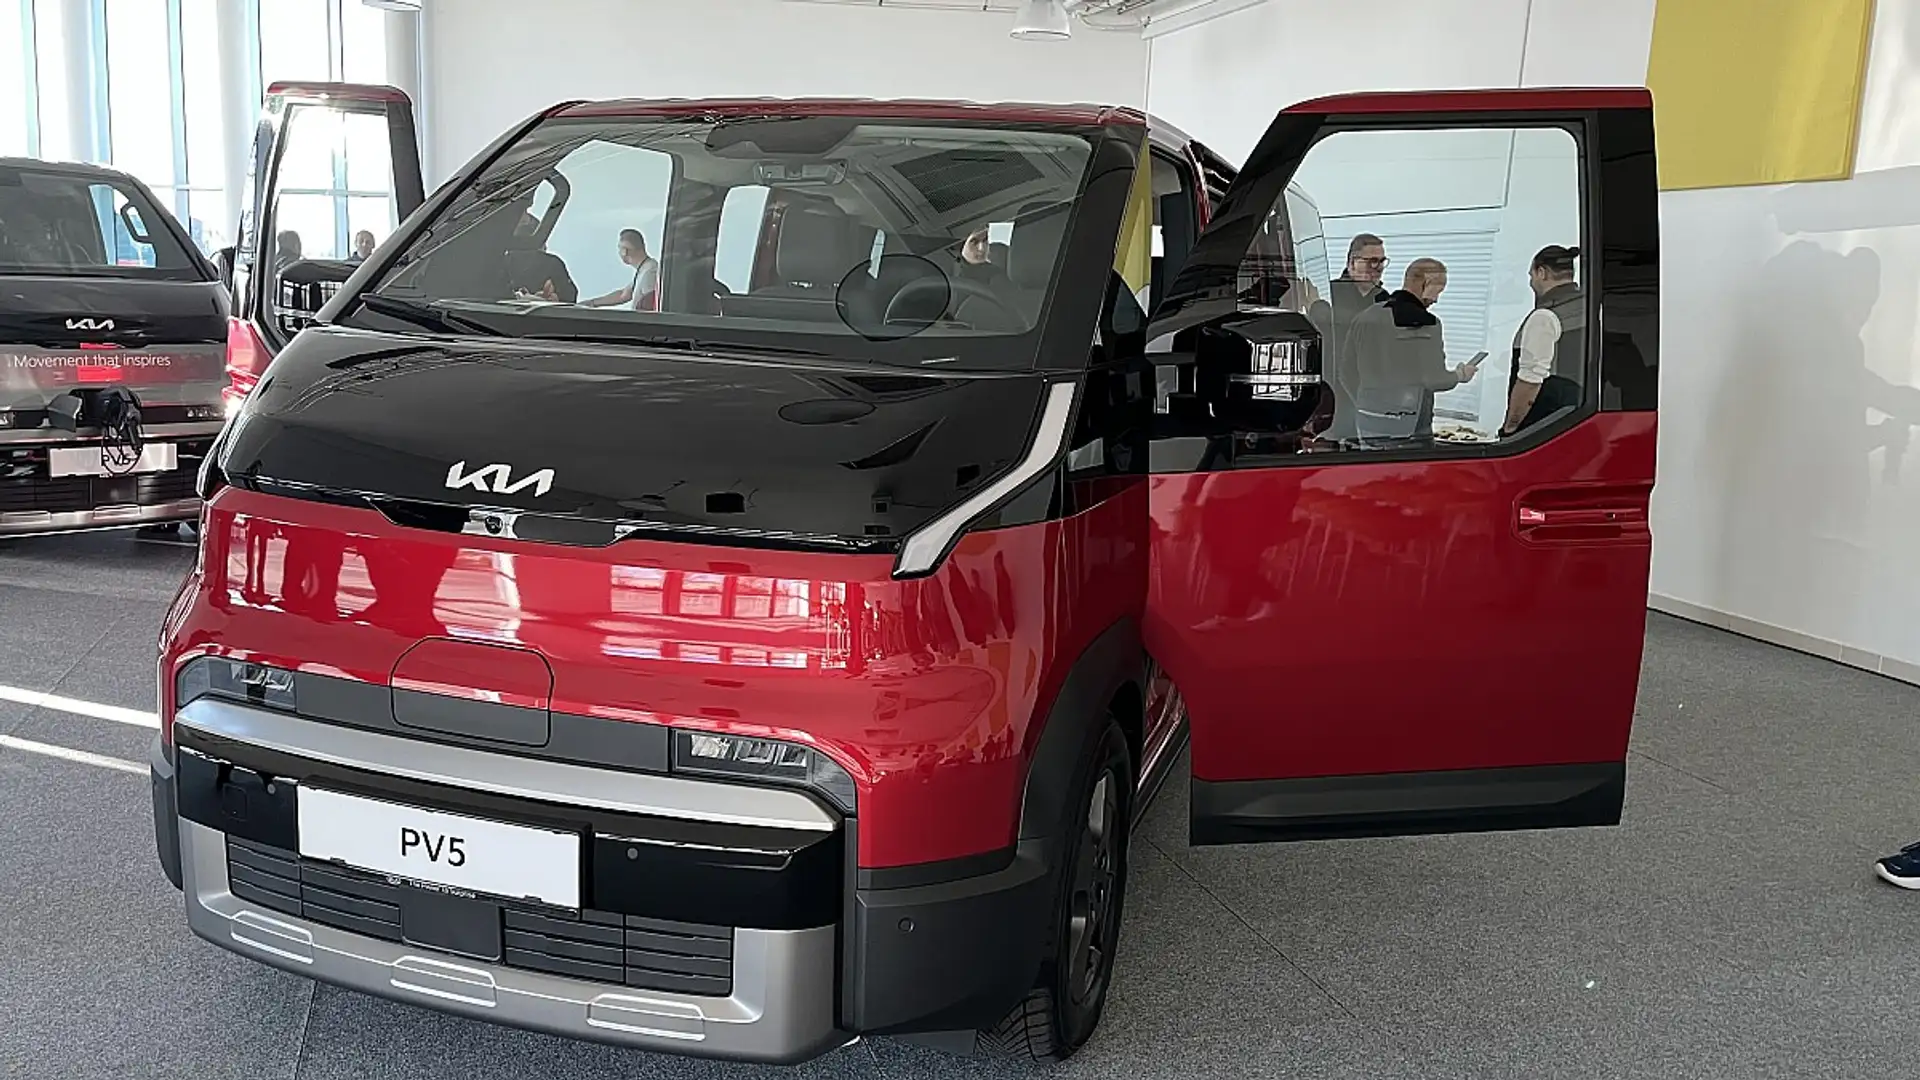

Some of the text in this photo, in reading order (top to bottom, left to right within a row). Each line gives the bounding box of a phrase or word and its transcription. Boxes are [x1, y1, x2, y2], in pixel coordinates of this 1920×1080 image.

[14, 353, 171, 368] Movement that inspires
[445, 460, 555, 497] KIA
[401, 826, 466, 867] PV5
